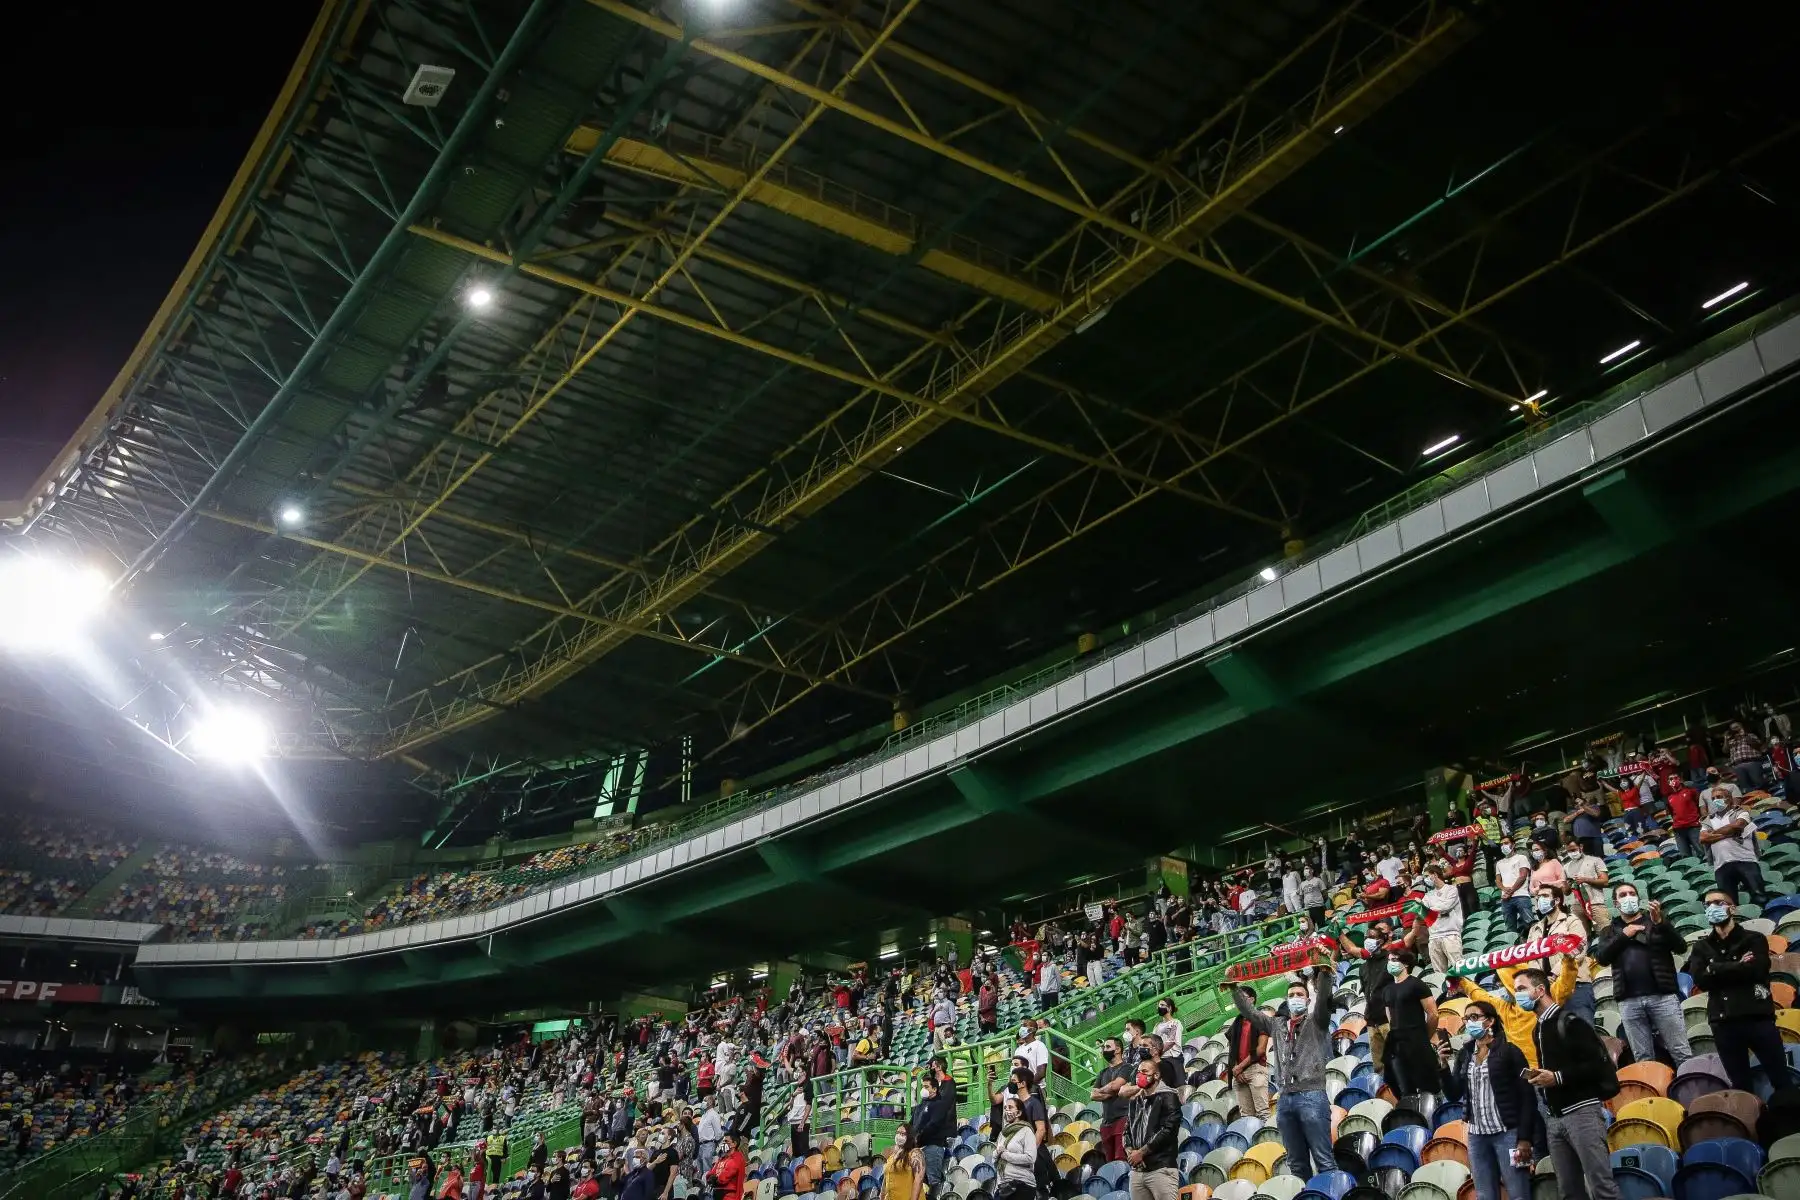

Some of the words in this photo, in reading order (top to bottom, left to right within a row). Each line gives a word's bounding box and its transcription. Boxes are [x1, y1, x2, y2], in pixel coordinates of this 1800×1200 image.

[1603, 763, 1643, 776] PORTUGAL
[1436, 827, 1470, 840] PORTUGAL
[1348, 906, 1399, 921] PORTUGAL
[1455, 937, 1551, 972] PORTUGAL
